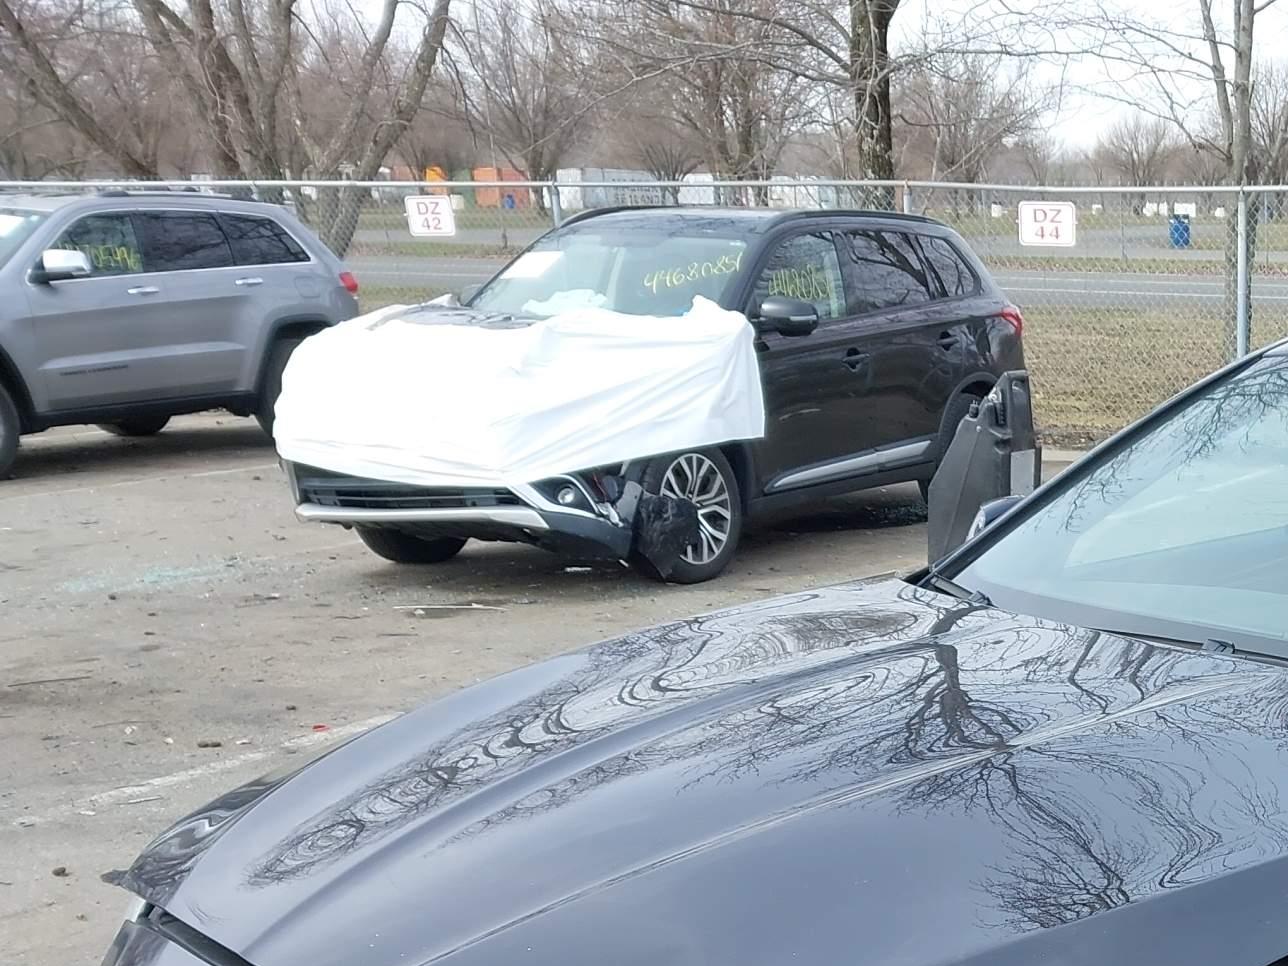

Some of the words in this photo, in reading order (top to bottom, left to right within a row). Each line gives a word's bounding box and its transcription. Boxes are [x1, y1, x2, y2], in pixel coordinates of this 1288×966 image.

[416, 201, 441, 215] DZ
[1033, 208, 1062, 223] DZ
[422, 217, 443, 230] 42
[1034, 226, 1060, 240] 44
[643, 251, 743, 294] 44680851
